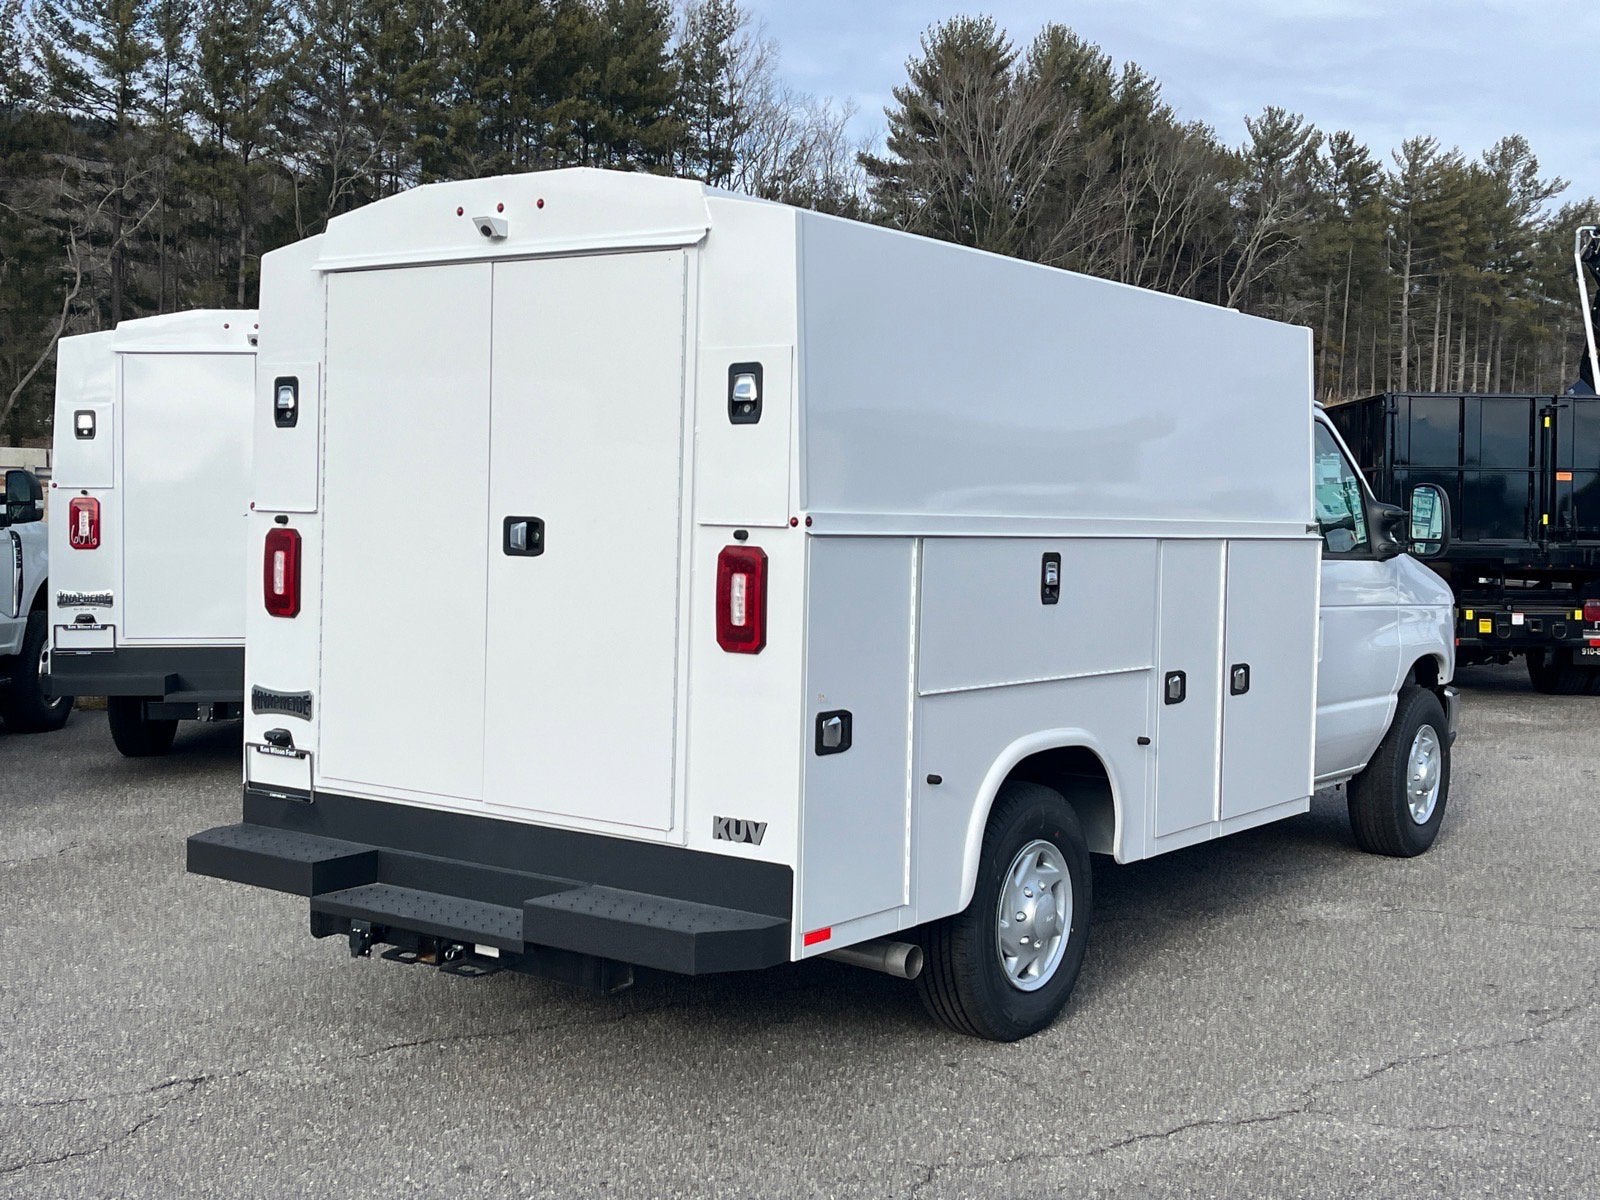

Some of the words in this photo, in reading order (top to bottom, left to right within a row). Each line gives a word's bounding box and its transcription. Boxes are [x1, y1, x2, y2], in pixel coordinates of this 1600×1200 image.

[57, 591, 113, 606] KNAPHEIDE
[252, 689, 312, 716] KNAPHEIDE
[713, 815, 768, 846] KUV
